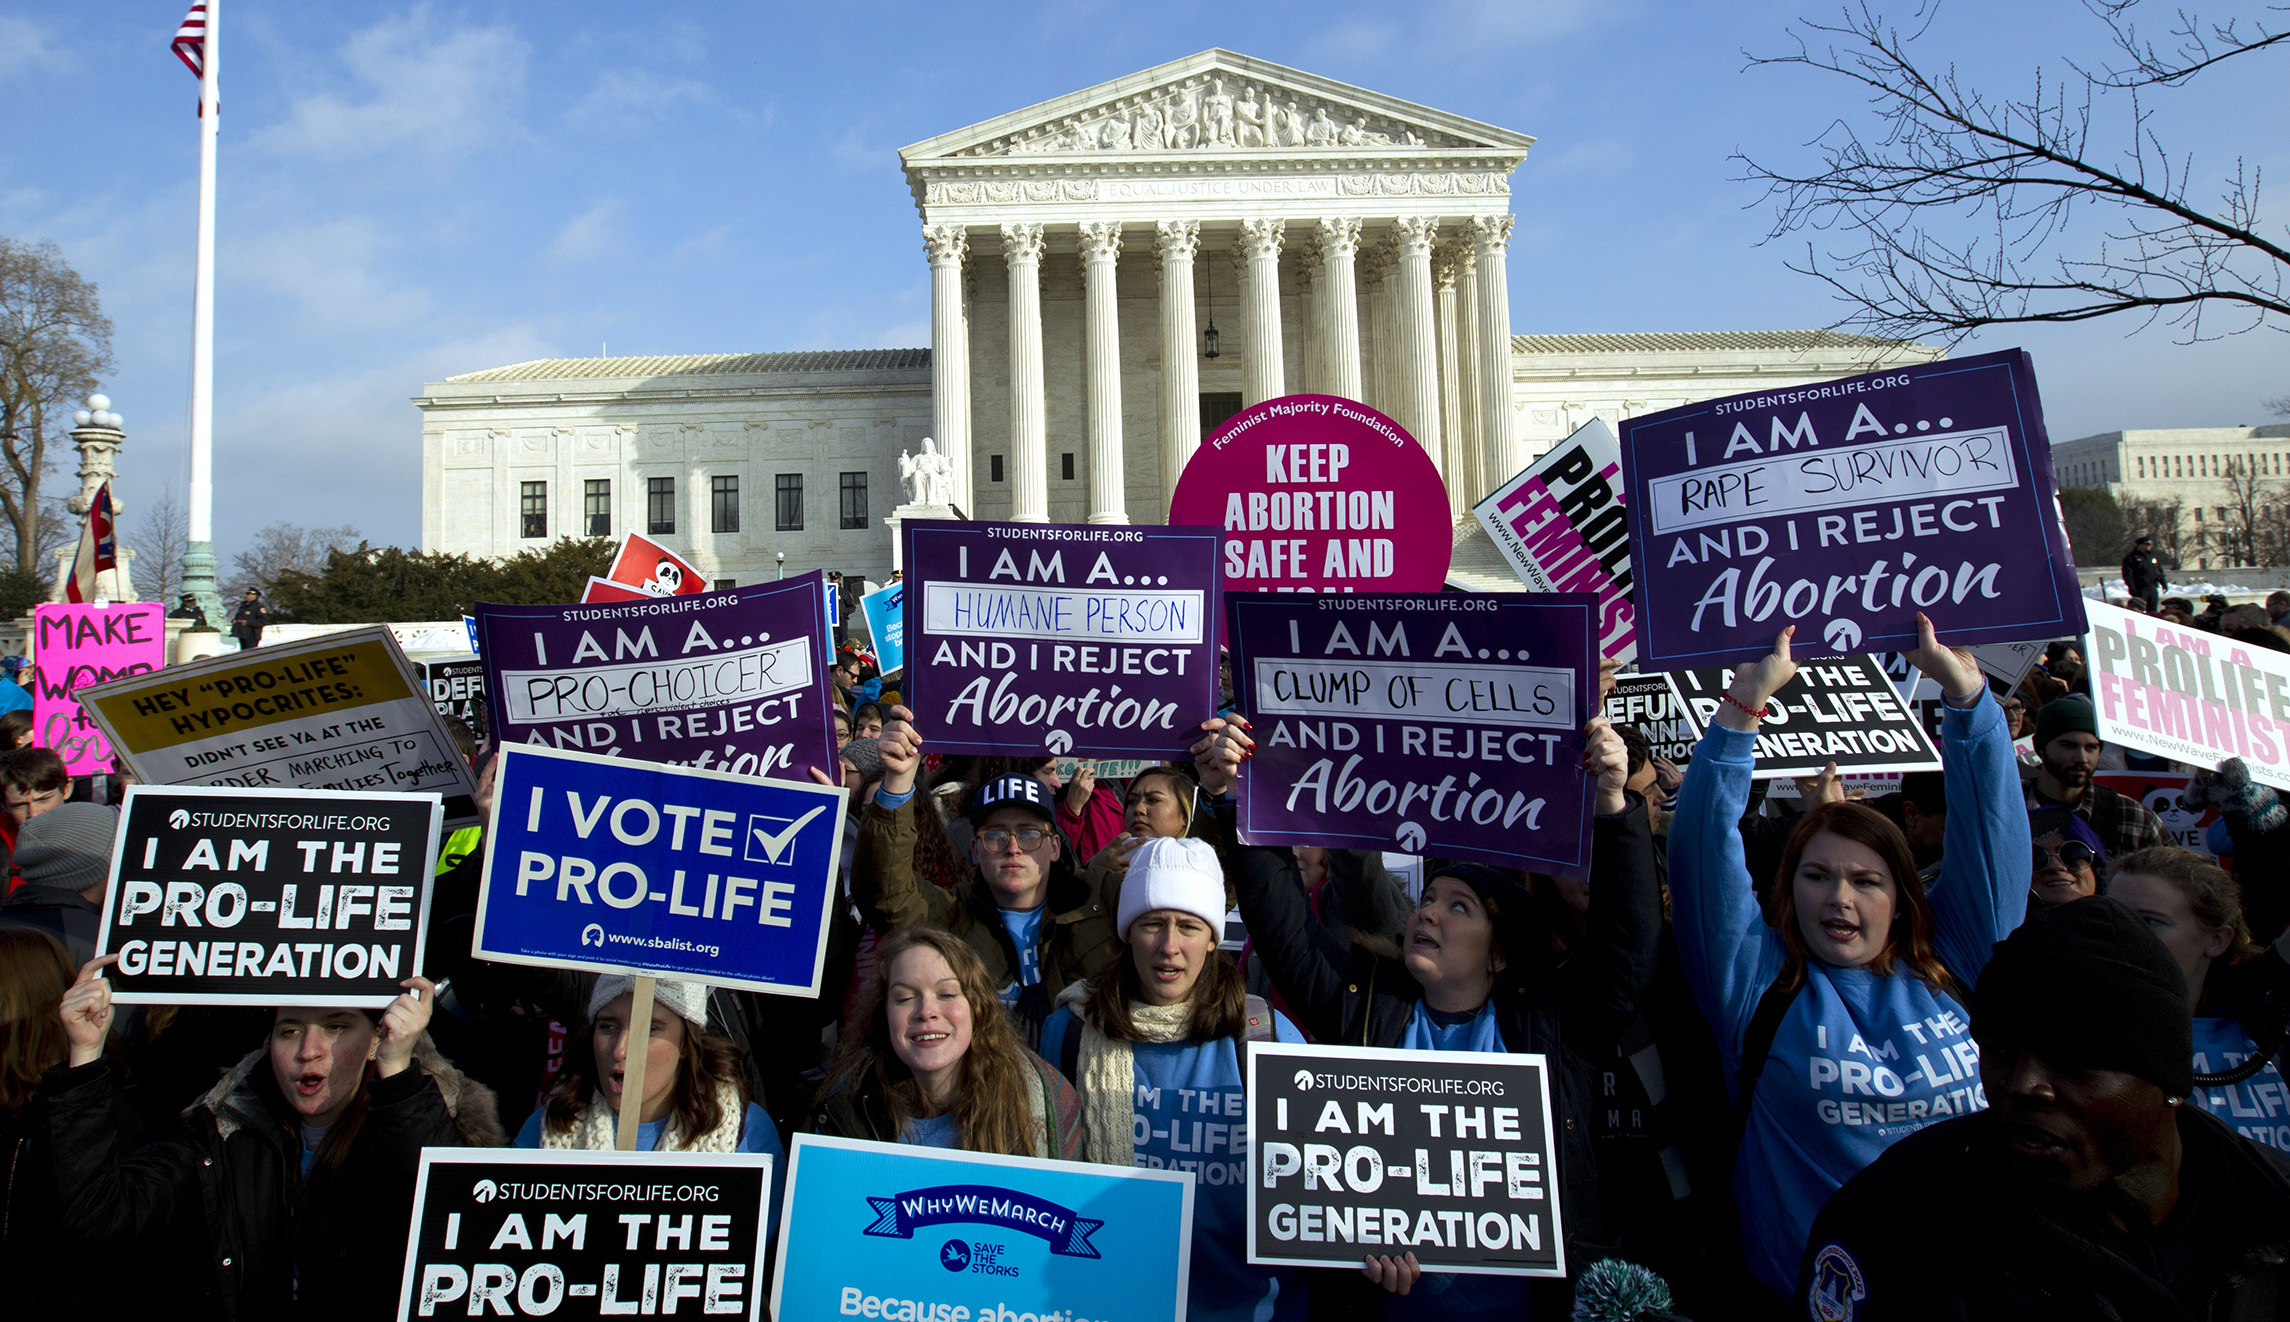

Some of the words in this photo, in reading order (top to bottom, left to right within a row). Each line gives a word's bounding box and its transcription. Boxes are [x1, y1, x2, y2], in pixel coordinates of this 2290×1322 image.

[1109, 183, 1165, 197] EQUAL
[1172, 182, 1231, 195] JUSTICE
[1238, 181, 1293, 194] UNDER
[1299, 180, 1330, 192] LAW
[1715, 373, 1911, 416] STUDENTSFORLIFE.ORG
[1212, 411, 1269, 451] Feminist
[1268, 401, 1330, 419] Majority
[1332, 403, 1405, 448] Foundation
[1684, 431, 1697, 466] I
[1723, 411, 1818, 460] AM
[1845, 402, 1954, 441] A...
[1266, 443, 1350, 484] KEEP
[1681, 467, 1769, 516] RAPE
[1800, 437, 1999, 494] SURVIVOR
[1224, 490, 1395, 531] ABORTION
[987, 527, 1144, 542] STUDENTSFORLIFE.ORG
[1666, 525, 1770, 569] AND
[1787, 520, 1799, 551] I
[1817, 495, 2006, 548] REJECT
[959, 546, 967, 578] I
[989, 547, 1066, 583] AM
[1086, 551, 1169, 586] A...
[1224, 539, 1308, 579] SAFE
[1323, 538, 1395, 578] AND
[562, 594, 739, 622] STUDENTSFORLIFE.ORG
[954, 592, 1074, 632] HUMANE
[1087, 596, 1187, 634] PERSON
[1318, 598, 1499, 611] STUDENTSFORLIFE.ORG
[1690, 552, 2002, 633] Abortion
[40, 612, 153, 650] MAKE
[534, 632, 547, 666] I
[571, 625, 659, 664] AM
[681, 619, 771, 655] A...
[1289, 619, 1300, 654] I
[1324, 620, 1411, 657] AM
[1434, 621, 1530, 661] A...
[2124, 618, 2137, 636] I
[2155, 627, 2212, 657] AM
[2230, 647, 2254, 668] A
[931, 639, 1017, 668] AND
[1030, 644, 1037, 670] I
[1053, 645, 1192, 675] REJECT
[2094, 624, 2290, 724] PROLIFE
[433, 675, 487, 702] DEF
[1273, 670, 1371, 703] CLUMP
[1387, 675, 1434, 709] OF
[1445, 678, 1556, 716] CELLS
[1685, 670, 1703, 691] I
[1797, 666, 1871, 687] THE
[132, 688, 193, 717] HEY
[170, 682, 364, 736] HYPOCRITES:
[525, 723, 617, 750] AND
[632, 719, 642, 743] I
[657, 693, 803, 741] REJECT
[945, 671, 1179, 731] Abortion
[184, 743, 249, 769] DIDN'T
[254, 736, 290, 753] SEE
[289, 730, 317, 746] YA
[321, 724, 345, 740] AT
[345, 717, 386, 735] THE
[287, 745, 384, 779] MARCHING
[387, 739, 416, 755] TO
[1268, 720, 1360, 751] AND
[1376, 724, 1385, 753] I
[1402, 726, 1562, 766] REJECT
[983, 777, 1039, 805] LIFE
[1285, 754, 1547, 831] Abortion
[191, 812, 391, 832] STUDENTSFORLIFE.ORG
[527, 786, 544, 833] I
[566, 791, 737, 857] VOTE
[143, 838, 159, 869] I
[182, 838, 270, 872] AM
[297, 840, 402, 874] THE
[118, 880, 415, 931] PRO-LIFE
[515, 850, 796, 928] PRO-LIFE
[117, 939, 402, 979] GENERATION
[608, 931, 720, 957] www.sbalist.org
[1817, 1025, 1827, 1049] I
[1848, 1033, 1900, 1063] AM
[1902, 1010, 1969, 1044] THE
[1178, 1089, 1243, 1117] THE
[1315, 1073, 1505, 1096] STUDENTSFORLIFE.ORG
[1277, 1098, 1288, 1131] I
[1315, 1100, 1395, 1136] AM
[1420, 1104, 1522, 1140] THE
[1263, 1141, 1544, 1200] PRO-LIFE
[498, 1183, 720, 1202] STUDENTSFORLIFE.ORG
[444, 1212, 461, 1250] I
[489, 1213, 588, 1250] AM
[618, 1214, 731, 1250] THE
[1268, 1203, 1541, 1251] GENERATION
[973, 1242, 1005, 1255] SAVE
[973, 1253, 998, 1265] THE
[418, 1263, 746, 1317] PRO-LIFE
[971, 1264, 1020, 1278] STORKS
[840, 1286, 971, 1322] Because
